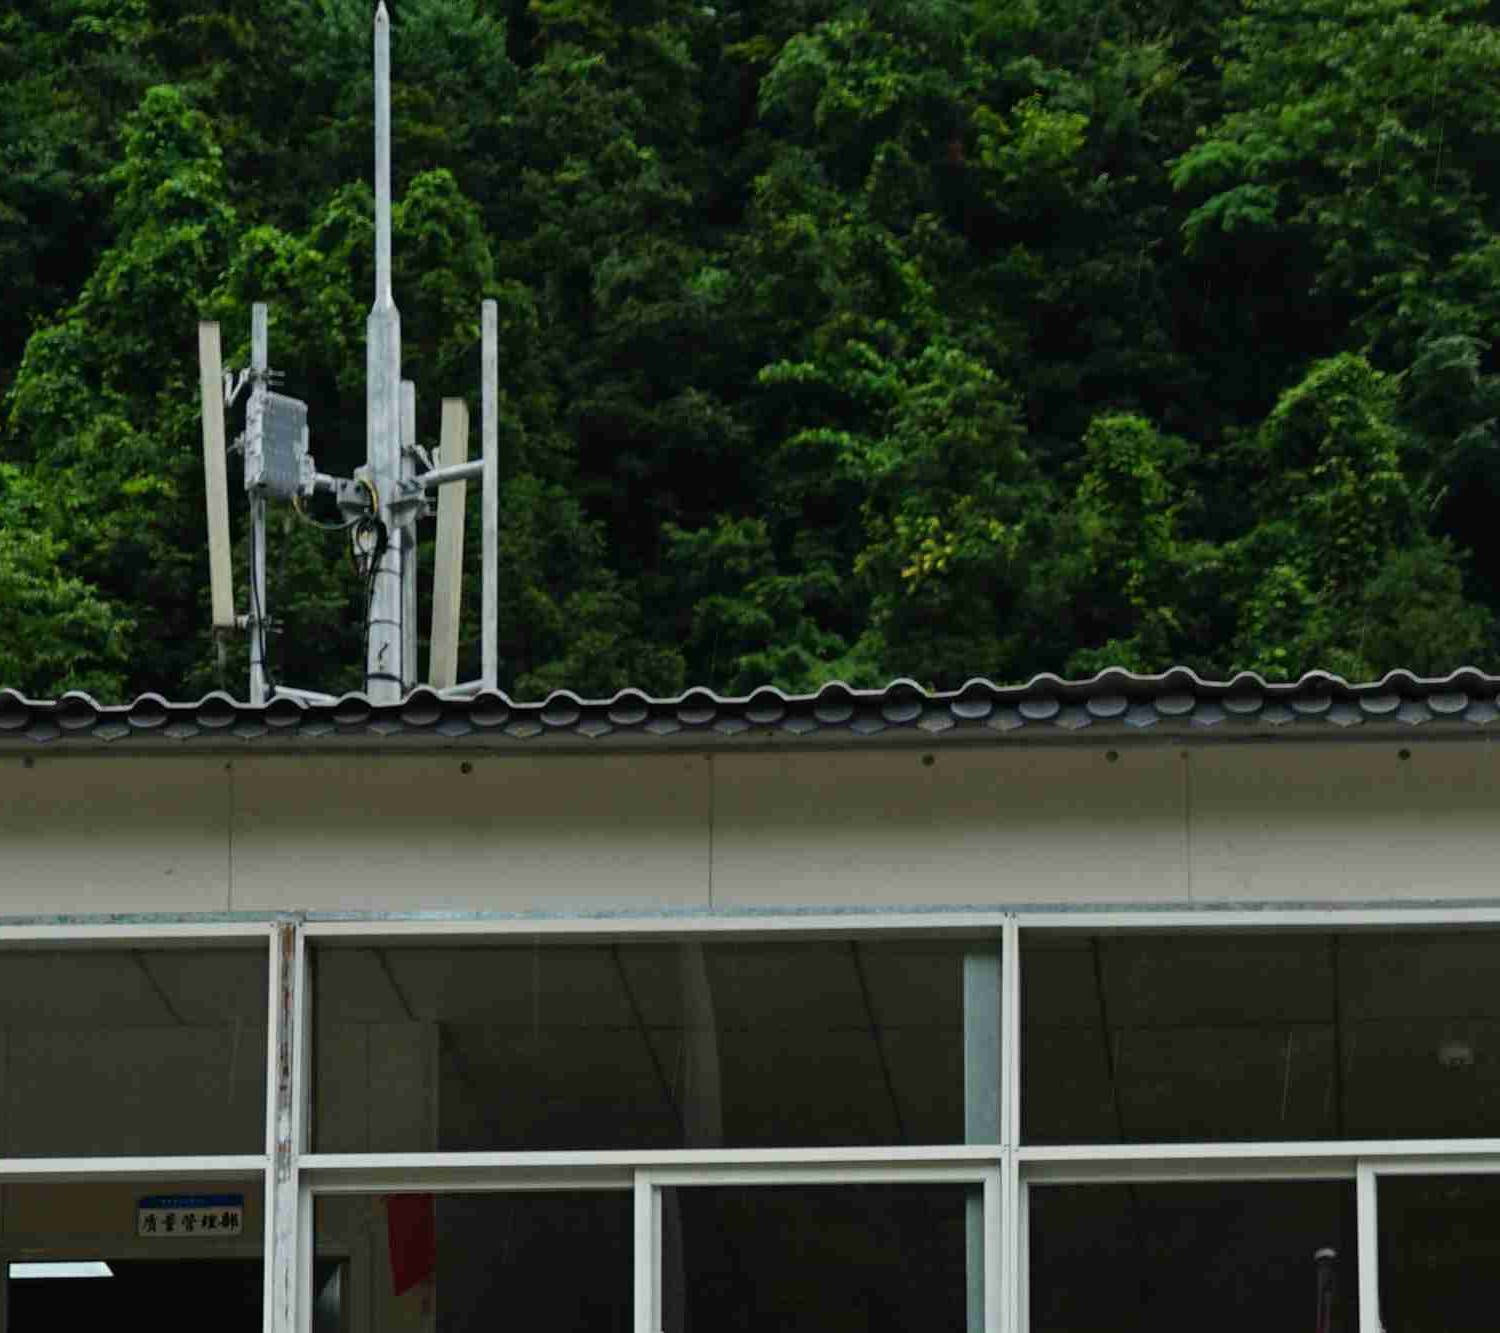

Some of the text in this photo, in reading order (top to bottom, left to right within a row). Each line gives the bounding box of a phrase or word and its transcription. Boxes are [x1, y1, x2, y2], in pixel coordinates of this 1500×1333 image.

[143, 1212, 238, 1232] 质量管理部
